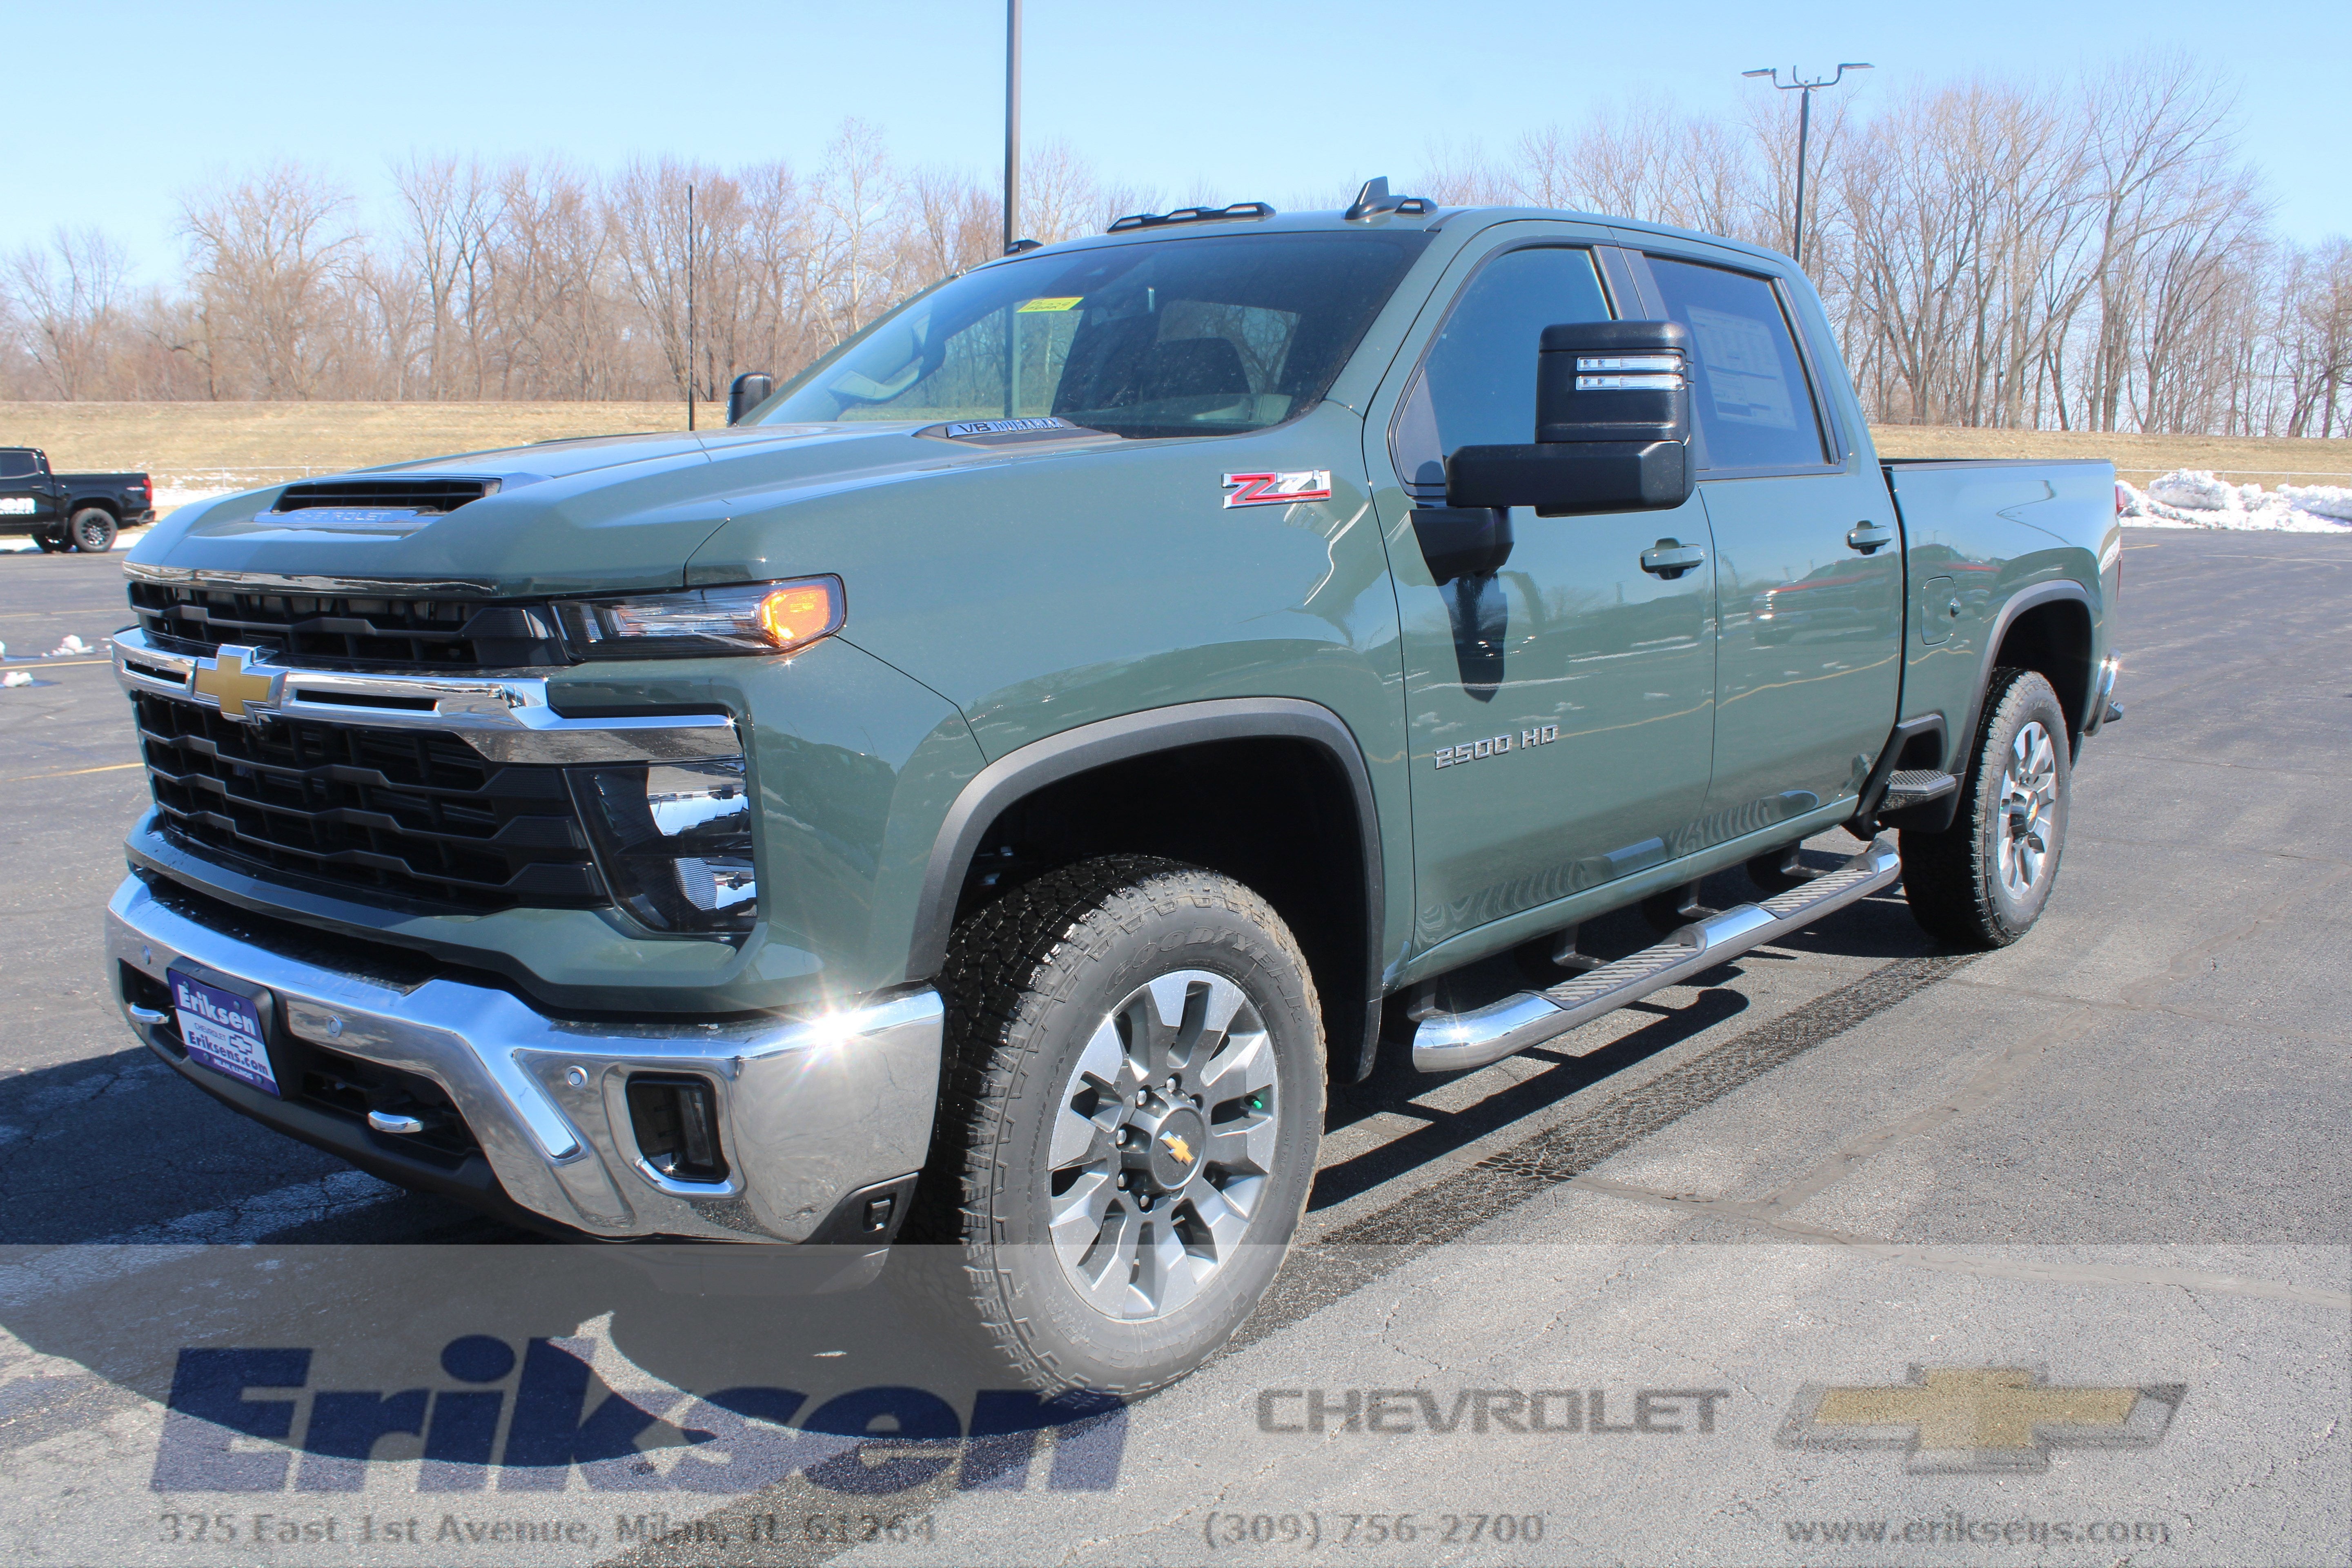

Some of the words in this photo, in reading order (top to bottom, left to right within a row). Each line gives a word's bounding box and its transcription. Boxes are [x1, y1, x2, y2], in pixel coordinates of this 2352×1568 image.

[0, 497, 36, 510] en
[1434, 734, 1512, 770] 2500
[1520, 724, 1559, 750] HD
[1105, 926, 1305, 1024] GOODYEAR
[177, 984, 257, 1036] Eriksen
[194, 1022, 227, 1042] CHEVROLET
[187, 1030, 270, 1076] Eriksens.com
